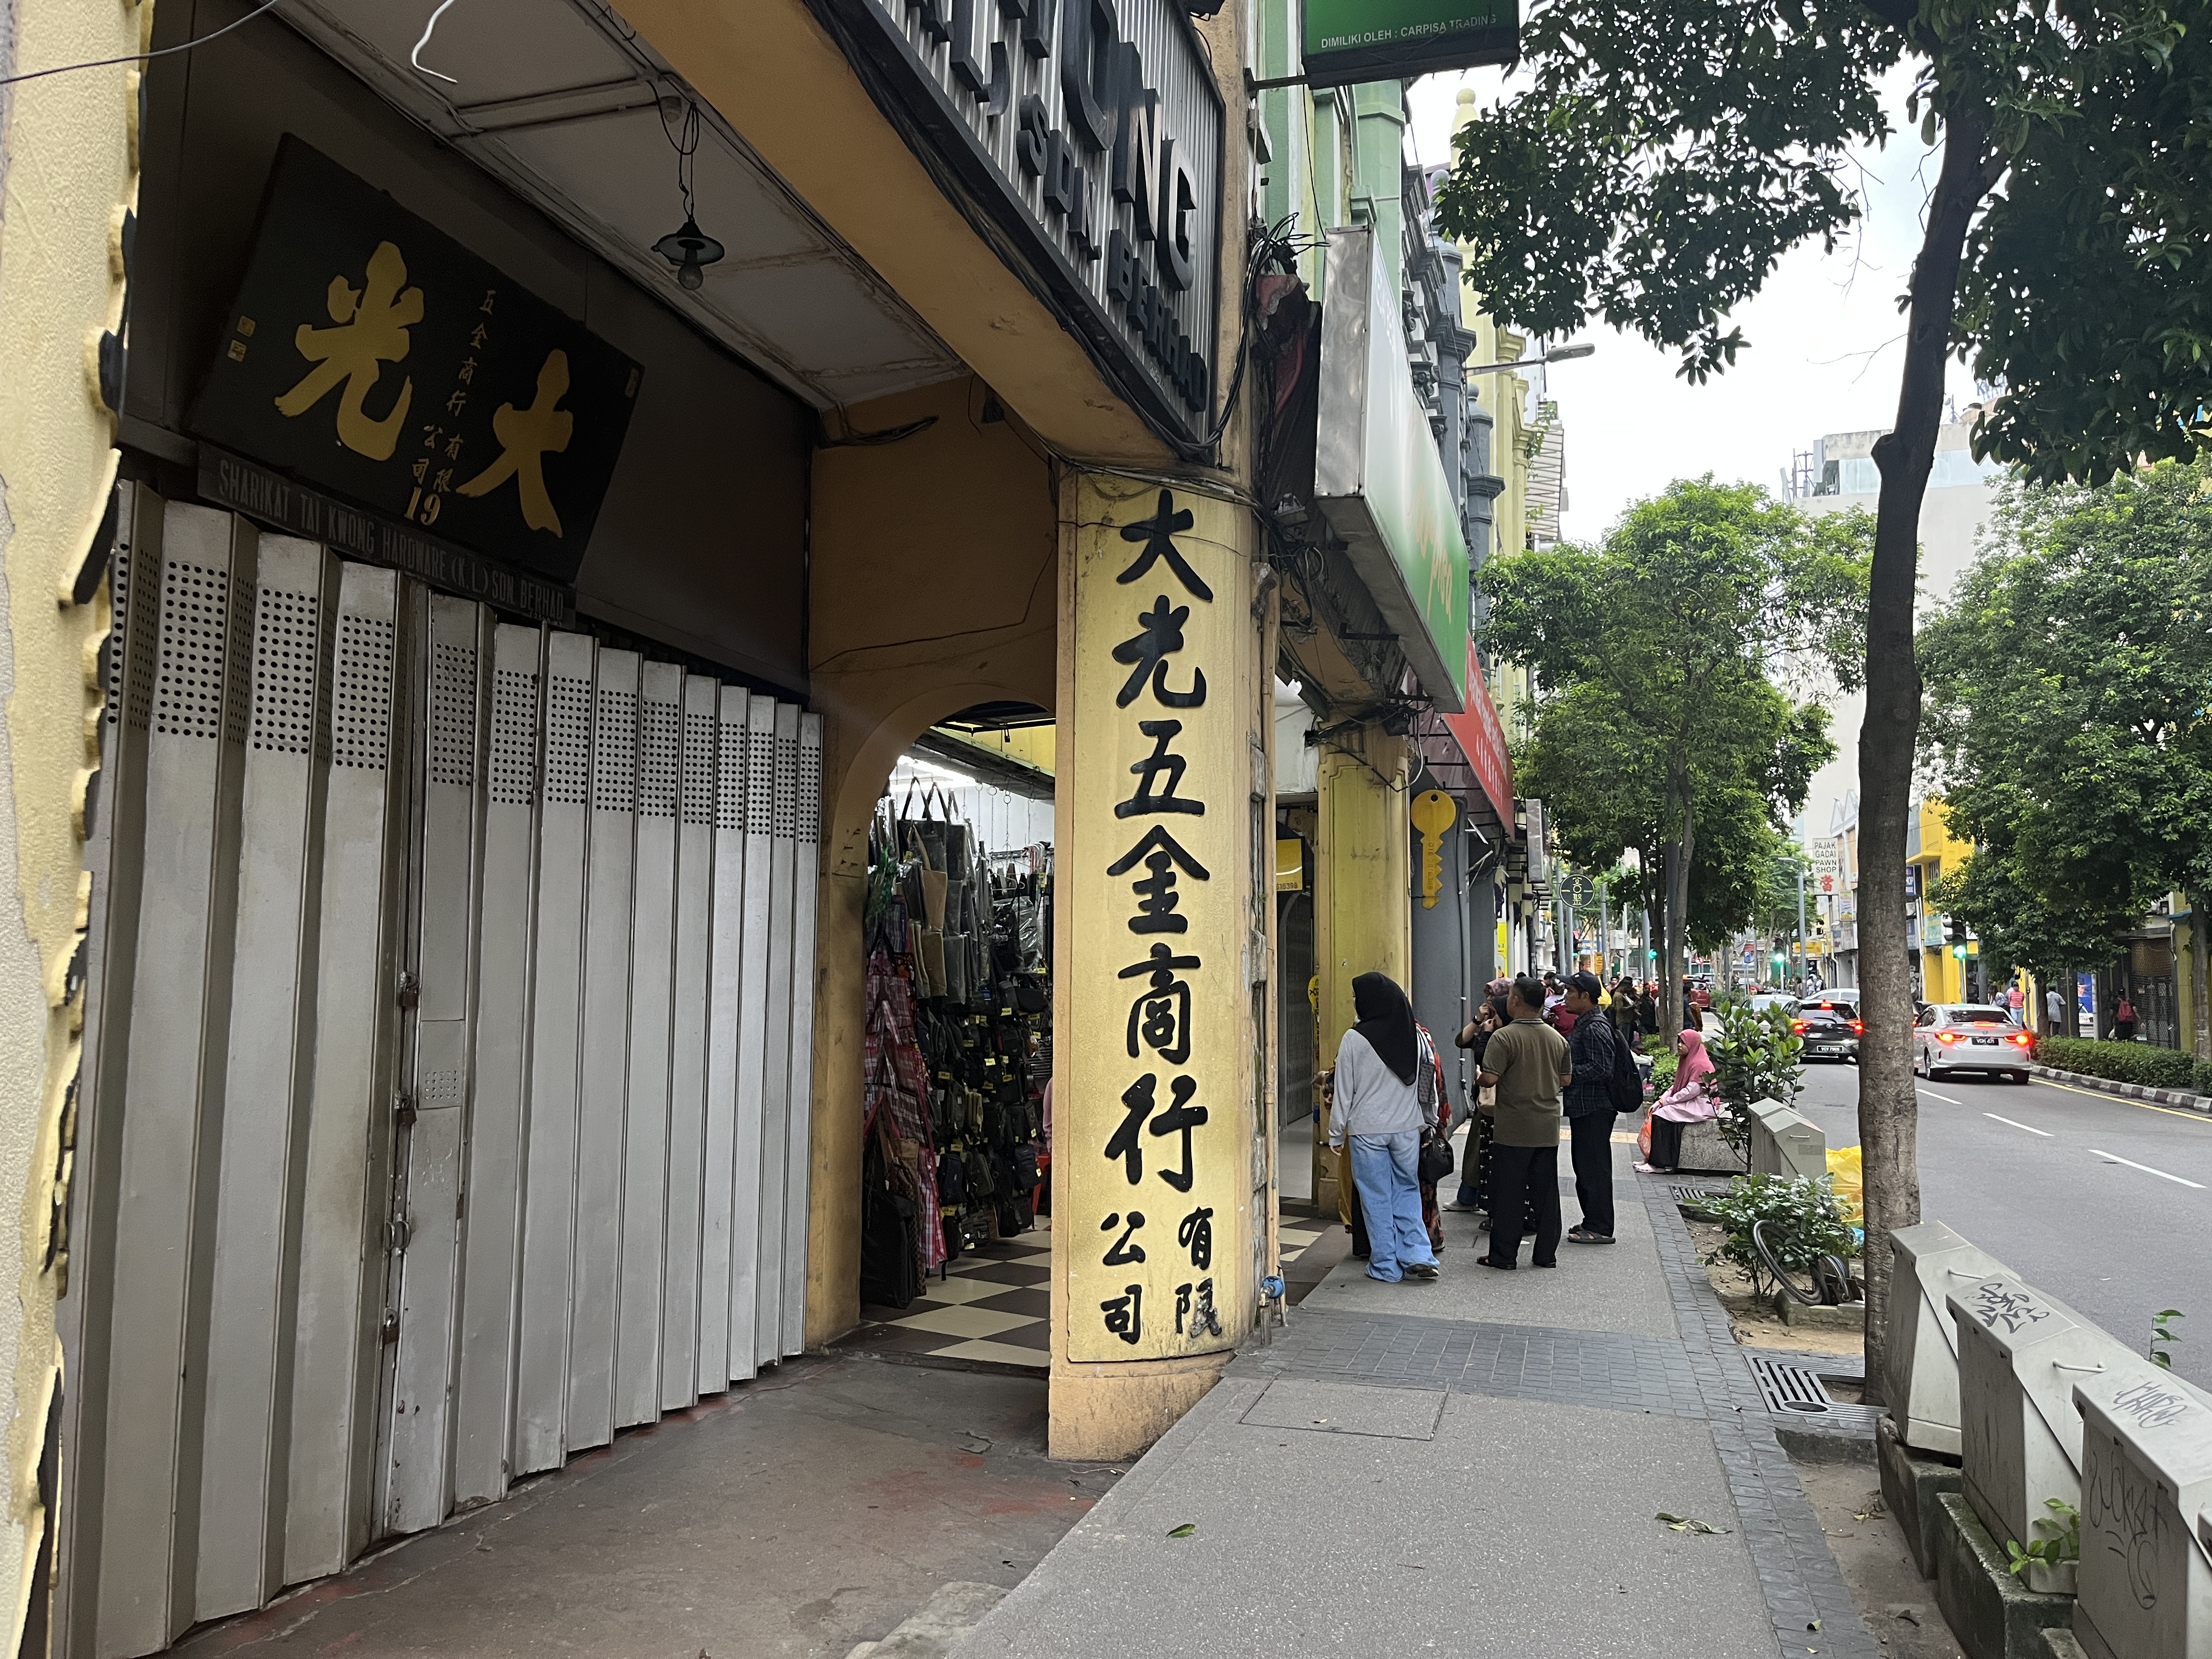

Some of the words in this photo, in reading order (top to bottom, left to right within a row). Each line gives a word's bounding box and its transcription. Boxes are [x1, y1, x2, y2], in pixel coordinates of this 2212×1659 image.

[1321, 35, 1361, 48] DIMILIKI
[1364, 29, 1392, 42] OLEH
[1401, 21, 1447, 37] CARPISA
[1449, 14, 1497, 30] TRADING
[1107, 229, 1207, 413] BERHAD
[445, 289, 499, 418] 五金商行
[403, 486, 442, 527] 19
[218, 459, 292, 522] SHARIKAT
[300, 492, 321, 532] TAI
[328, 509, 376, 555] KWONG
[382, 525, 448, 584] HARDWARE
[520, 579, 565, 621] BERHAD
[1814, 842, 1836, 850] PAJAK
[1815, 850, 1836, 858] GADAI
